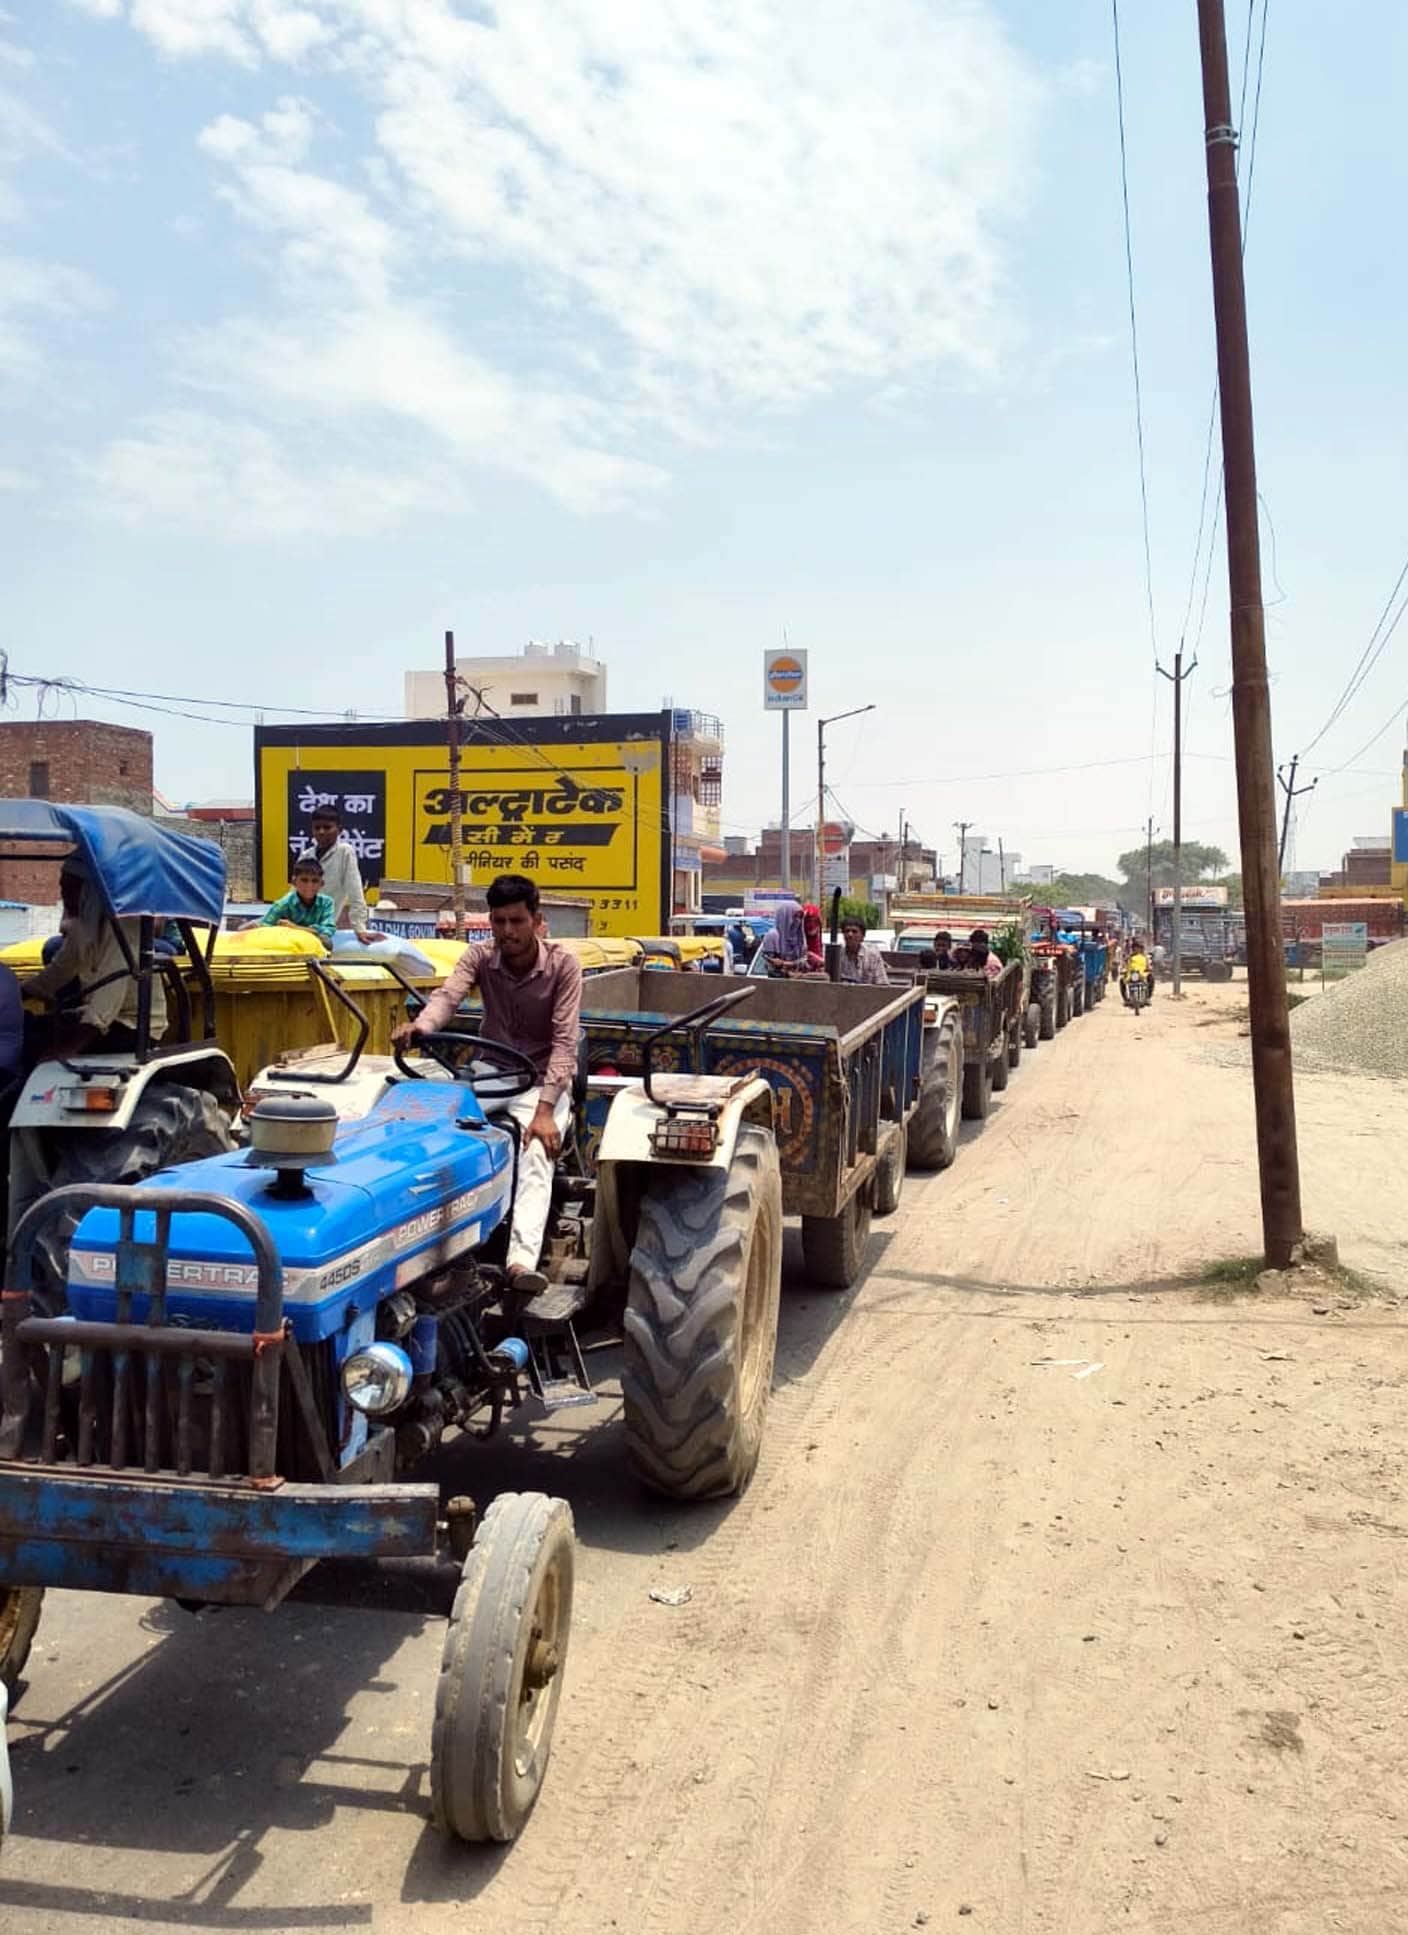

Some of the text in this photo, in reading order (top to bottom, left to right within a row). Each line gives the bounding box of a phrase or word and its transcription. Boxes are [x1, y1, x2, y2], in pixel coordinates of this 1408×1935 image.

[343, 794, 376, 813] का
[520, 851, 539, 869] की
[93, 1258, 289, 1286] PERTRA
